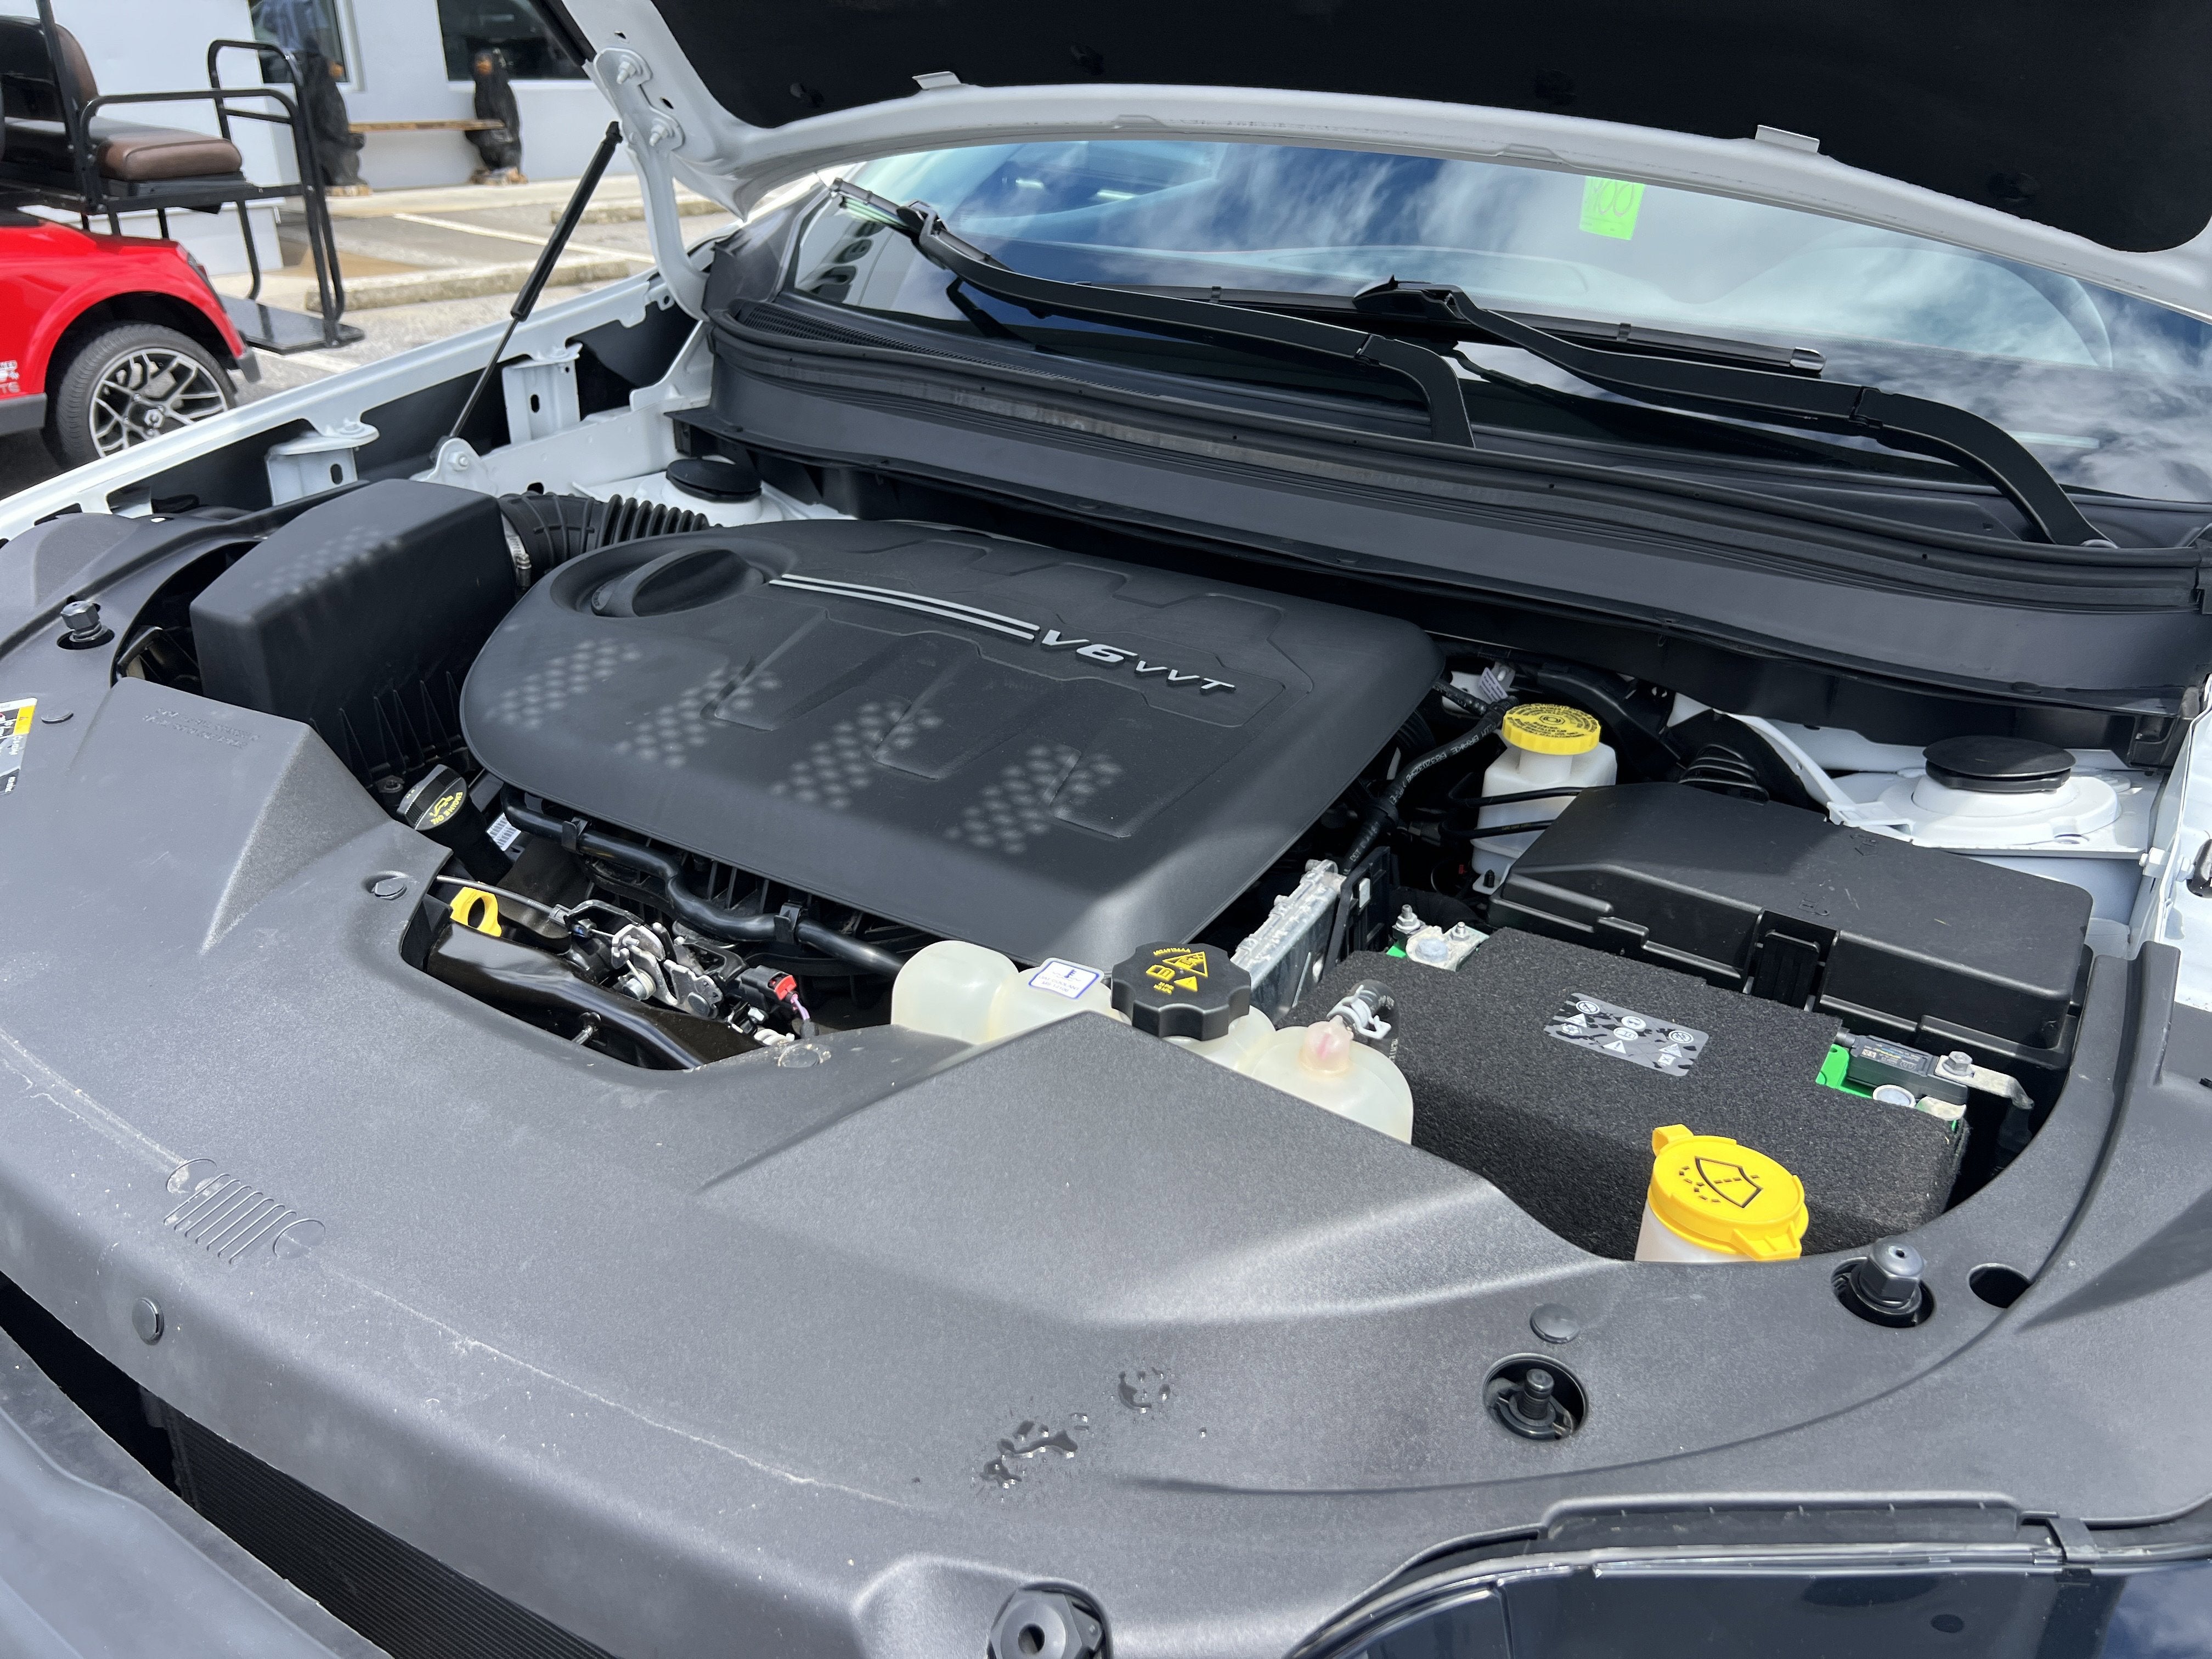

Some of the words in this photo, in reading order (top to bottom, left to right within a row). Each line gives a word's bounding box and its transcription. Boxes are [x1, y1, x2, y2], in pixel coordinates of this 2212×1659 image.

[1042, 629, 1139, 663] V6
[1135, 660, 1235, 690] VVT
[1450, 734, 1480, 755] BRAKE
[443, 792, 463, 817] ENGINE
[431, 815, 444, 825] OIL
